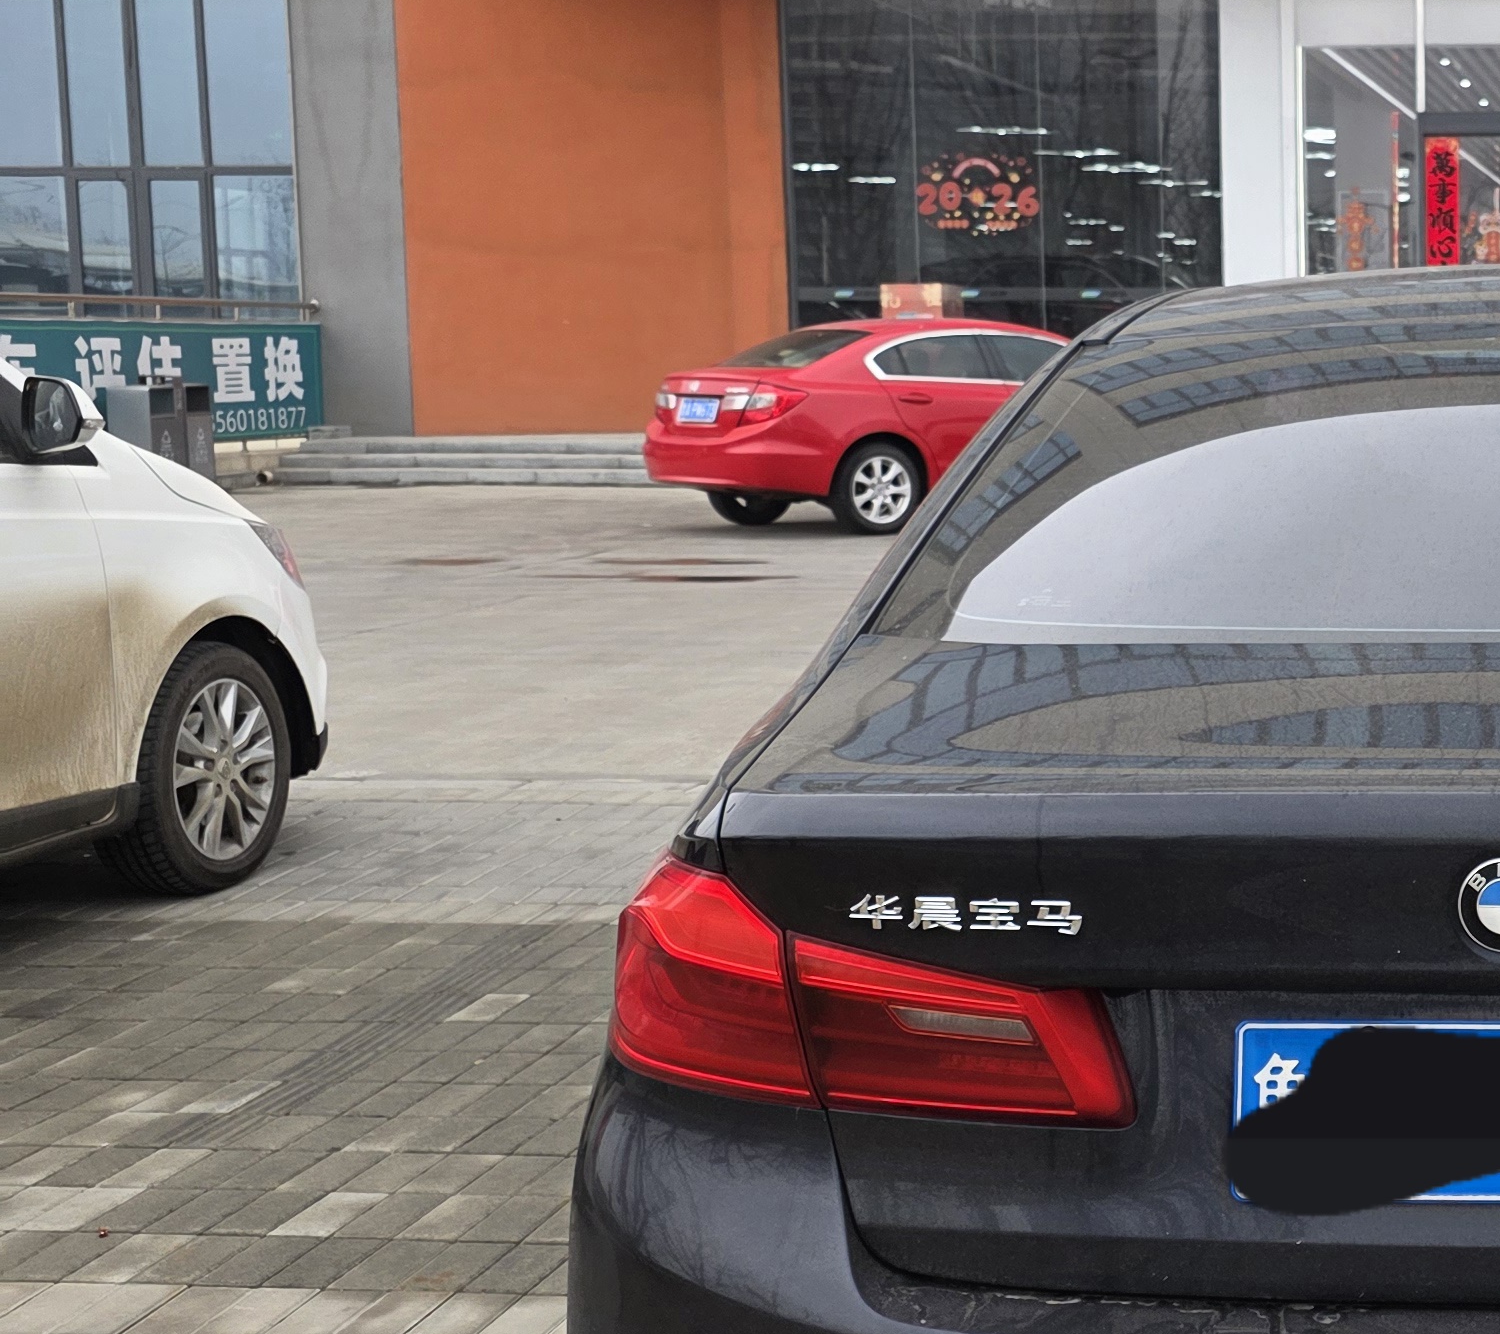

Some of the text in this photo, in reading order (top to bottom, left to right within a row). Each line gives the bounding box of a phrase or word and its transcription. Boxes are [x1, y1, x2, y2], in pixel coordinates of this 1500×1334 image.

[1428, 151, 1457, 266] 萬事順心
[212, 336, 304, 403] 置换
[212, 407, 306, 433] 560181877
[849, 893, 1083, 935] 华晨宝马
